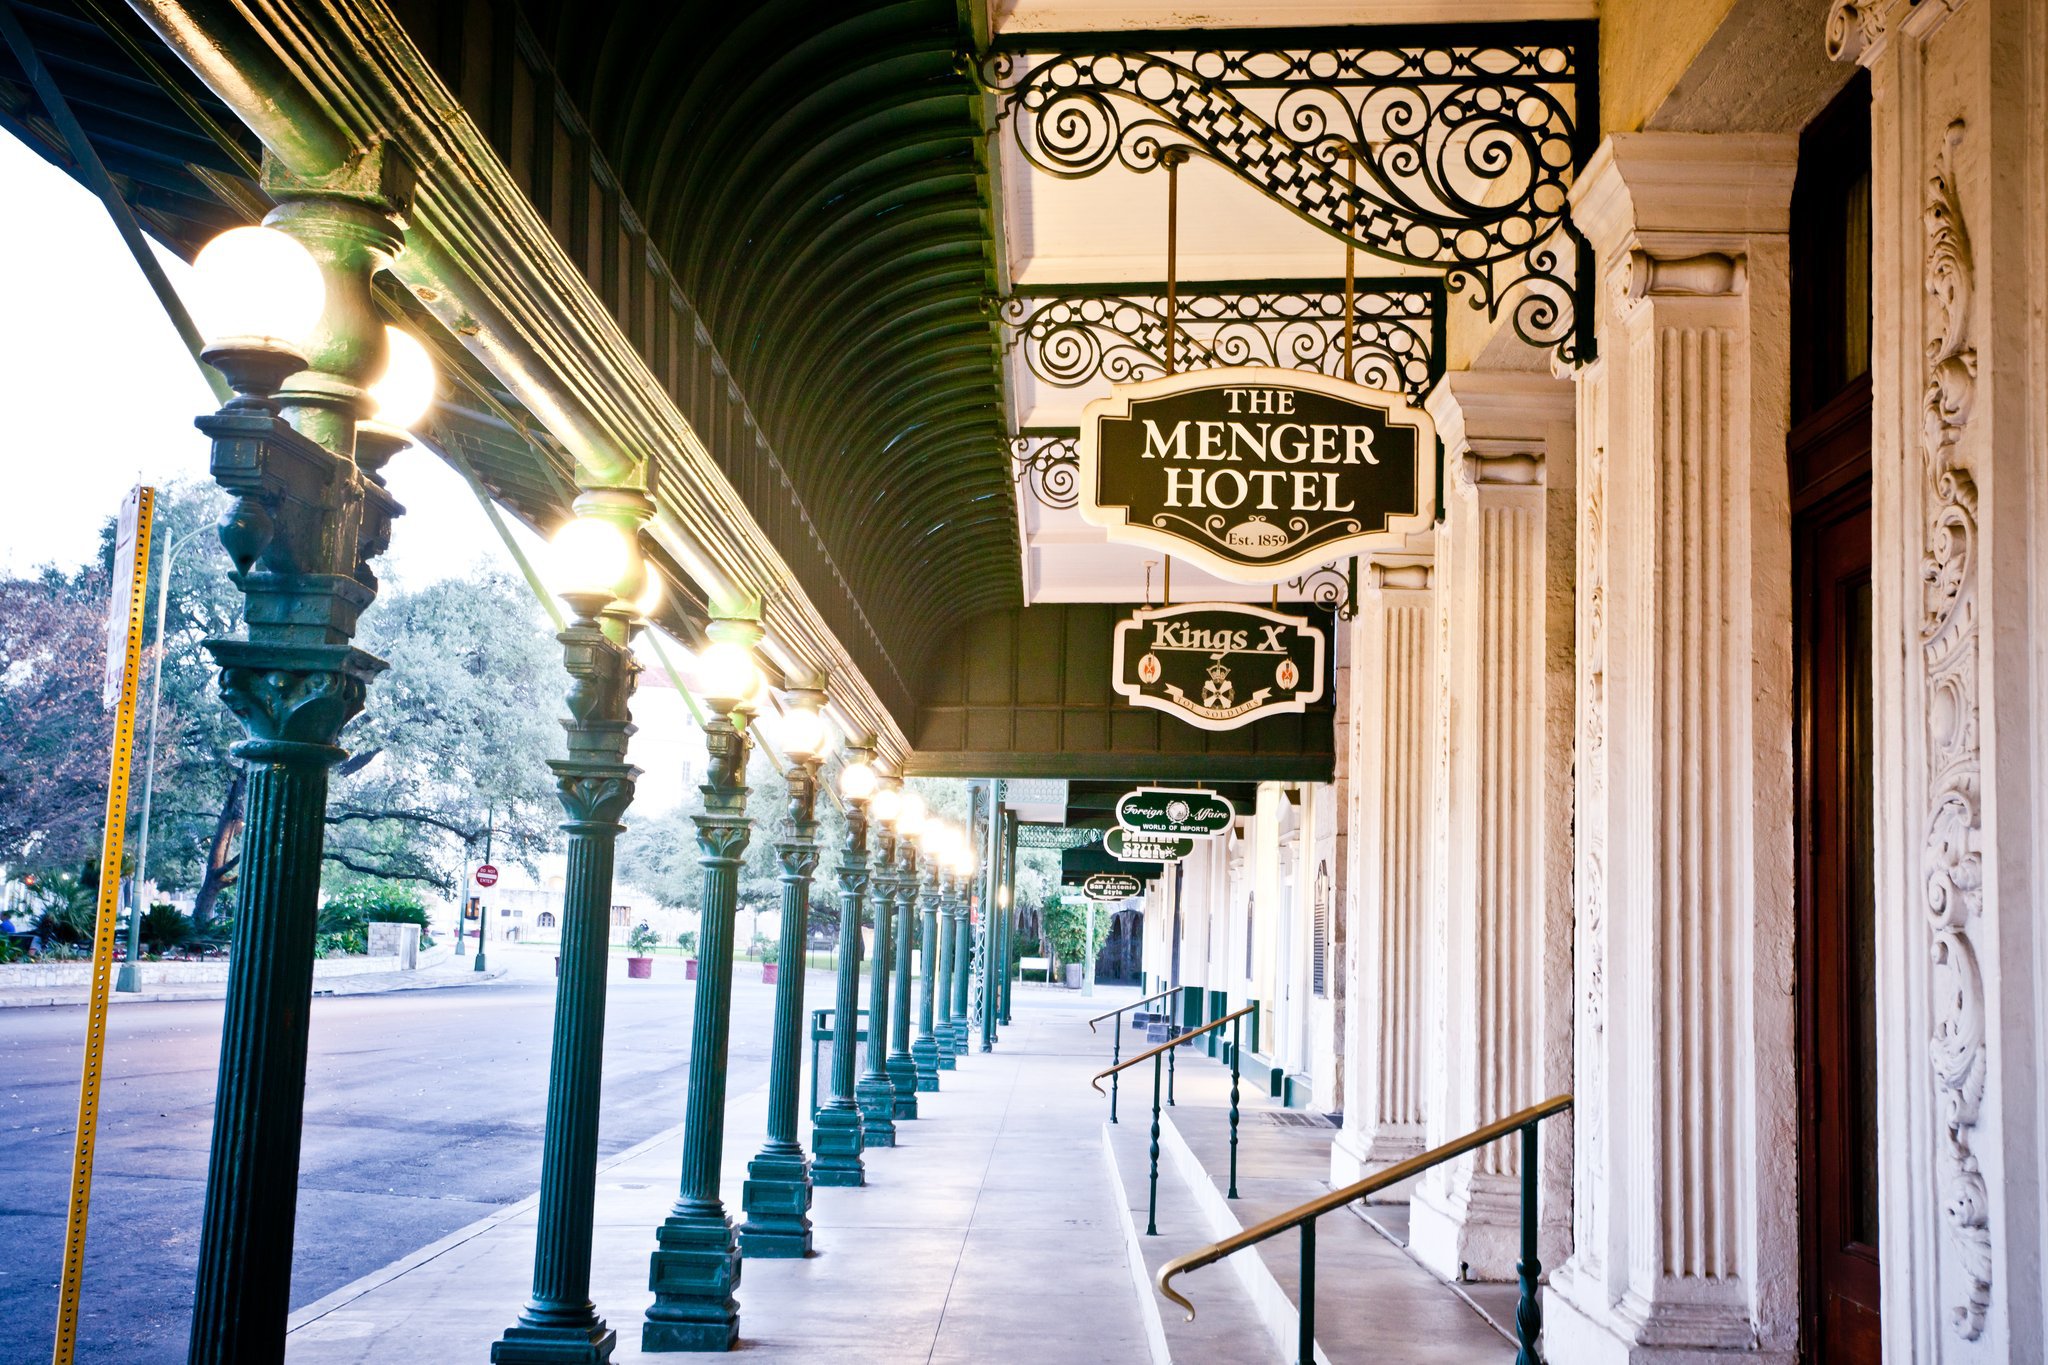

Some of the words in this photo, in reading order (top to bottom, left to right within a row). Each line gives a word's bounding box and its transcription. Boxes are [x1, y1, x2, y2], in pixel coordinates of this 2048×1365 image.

[1224, 389, 1296, 415] THE
[1141, 419, 1380, 465] MENGER
[1163, 467, 1355, 512] HOTEL
[1228, 532, 1254, 546] Est.
[1257, 533, 1288, 547] 1859
[1151, 621, 1248, 660] Kings
[1256, 625, 1288, 651] X
[1177, 696, 1197, 710] TOY
[1204, 699, 1260, 719] SOLDIERS
[1123, 804, 1164, 819] Foreign
[1142, 823, 1167, 831] WORLD
[1180, 825, 1209, 833] IMPORTS
[1122, 842, 1166, 859] SPUR
